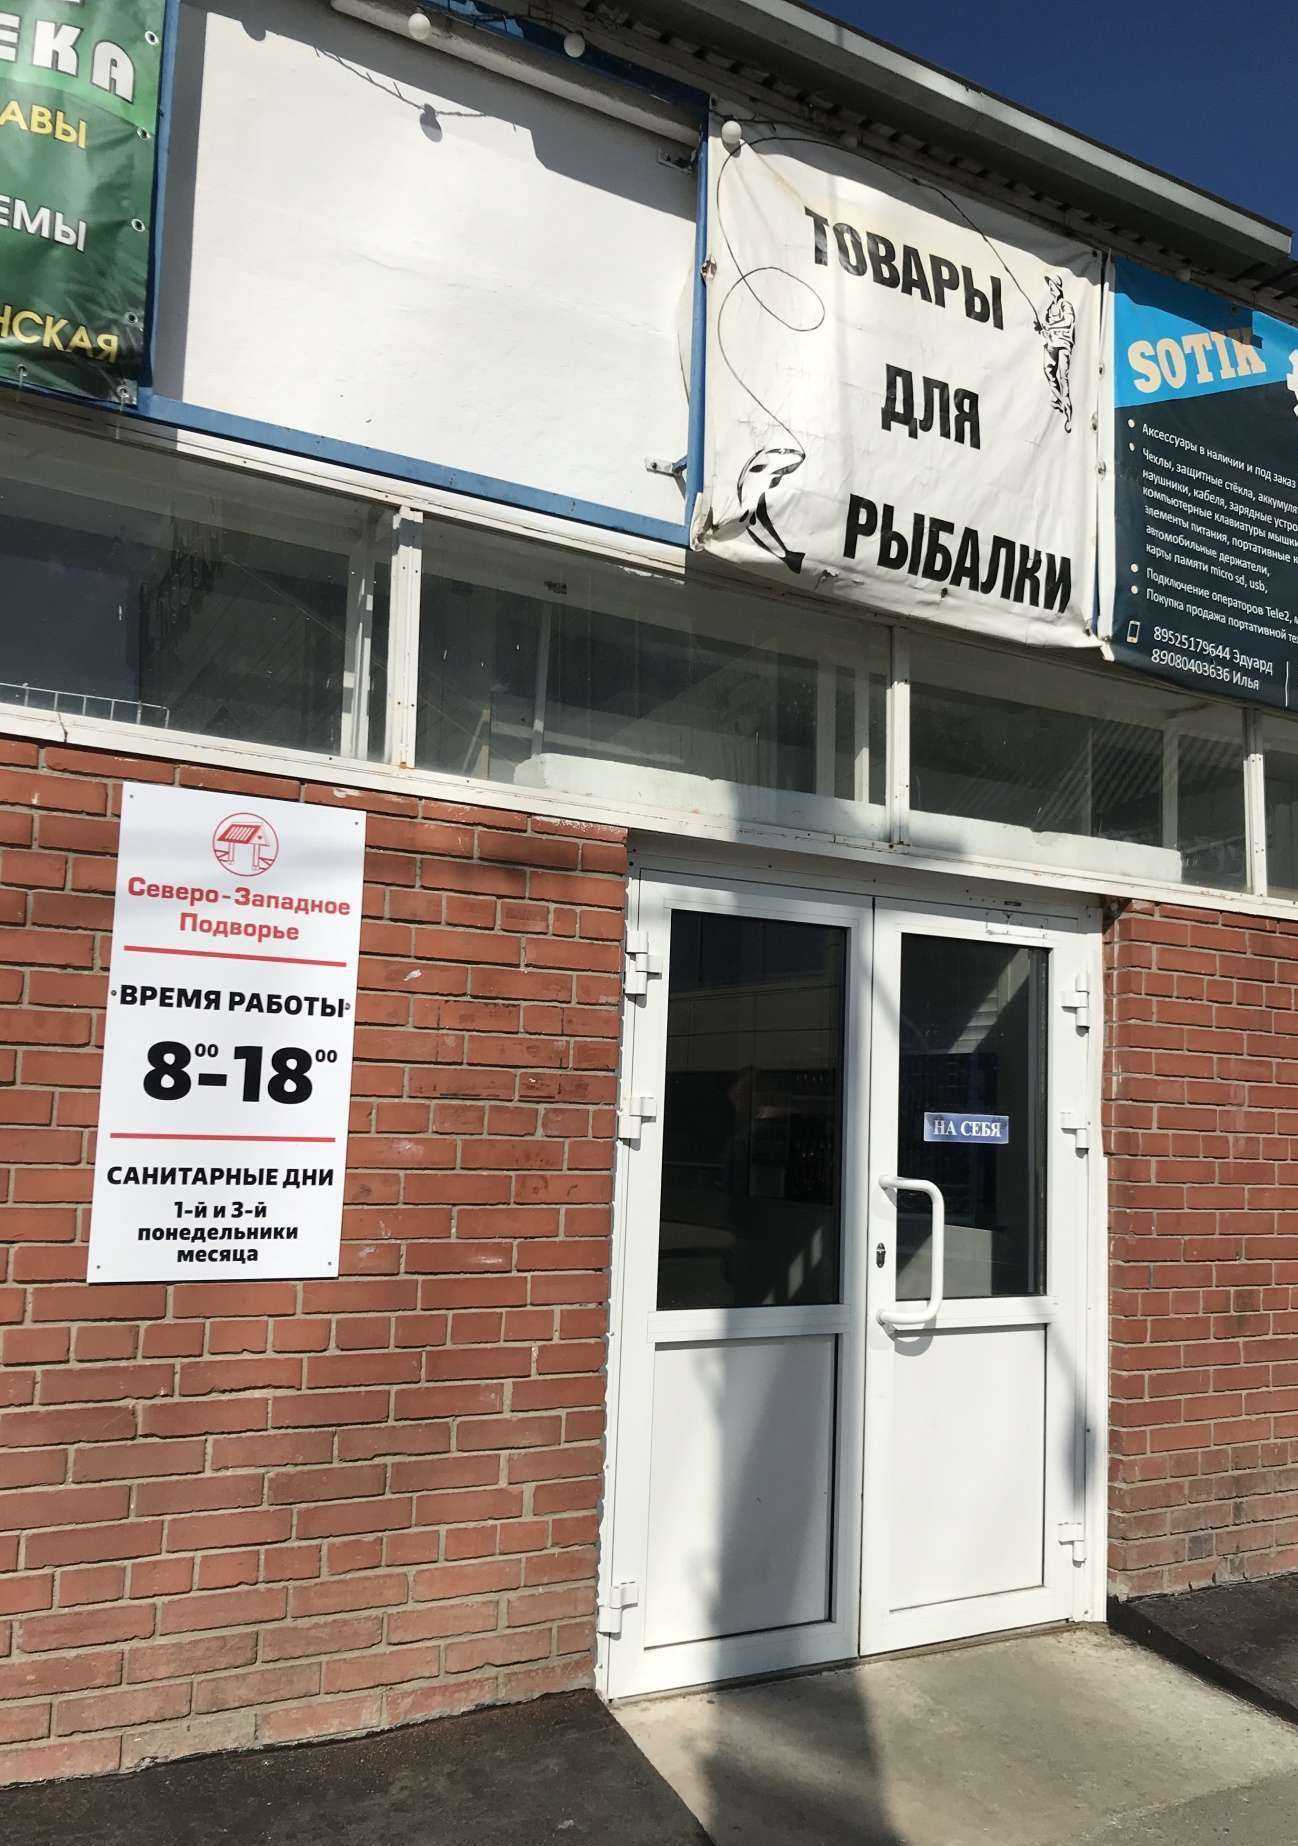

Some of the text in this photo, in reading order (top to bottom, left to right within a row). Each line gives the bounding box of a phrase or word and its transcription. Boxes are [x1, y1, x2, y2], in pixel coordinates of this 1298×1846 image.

[804, 207, 1004, 330] ТОВАРЫ
[881, 363, 981, 449] ДЛЯ
[1142, 424, 1197, 451] Аксессуары
[1206, 450, 1245, 471] наличии
[1254, 466, 1272, 482] под
[1272, 473, 1297, 489] заказ
[1142, 447, 1175, 472] Чехлы,
[1175, 463, 1224, 488] защитные
[1258, 493, 1298, 514] аккумуля
[1142, 469, 1191, 497] наушники,
[1193, 489, 1227, 509] кабеля,
[1229, 501, 1273, 524] зарядные
[1142, 487, 1213, 519] компьютерные
[1214, 513, 1266, 537] клавиатуры
[843, 493, 1072, 613] РЫБАЛКИ
[1144, 505, 1189, 529] элементы
[1191, 522, 1230, 546] питания,
[1231, 537, 1291, 562] портативные
[1146, 525, 1270, 578] автомобильные держатели,
[1146, 544, 1268, 594] карты памяти micro sd, usb,
[1146, 567, 1210, 599] Подключение
[1211, 591, 1264, 616] операторов
[1265, 606, 1293, 624] Tele2,
[1146, 588, 1184, 611] Покупка
[1186, 604, 1226, 624] продажа
[1228, 616, 1287, 640] портативной
[1151, 649, 1260, 691] 89080403636 Илья
[1153, 626, 1273, 676] 89525179644 Эдуард
[179, 912, 300, 942] Подворье
[119, 984, 345, 1018] ВРЕМЯ РАБОТЫ
[934, 1119, 1001, 1137] НА СЕБЯ
[107, 1166, 334, 1189] САНИТАРНЫЕ ДНИ
[138, 1225, 299, 1243] понедельники
[174, 1200, 267, 1218] 1-й и 3-й
[176, 1248, 259, 1264] месяца
